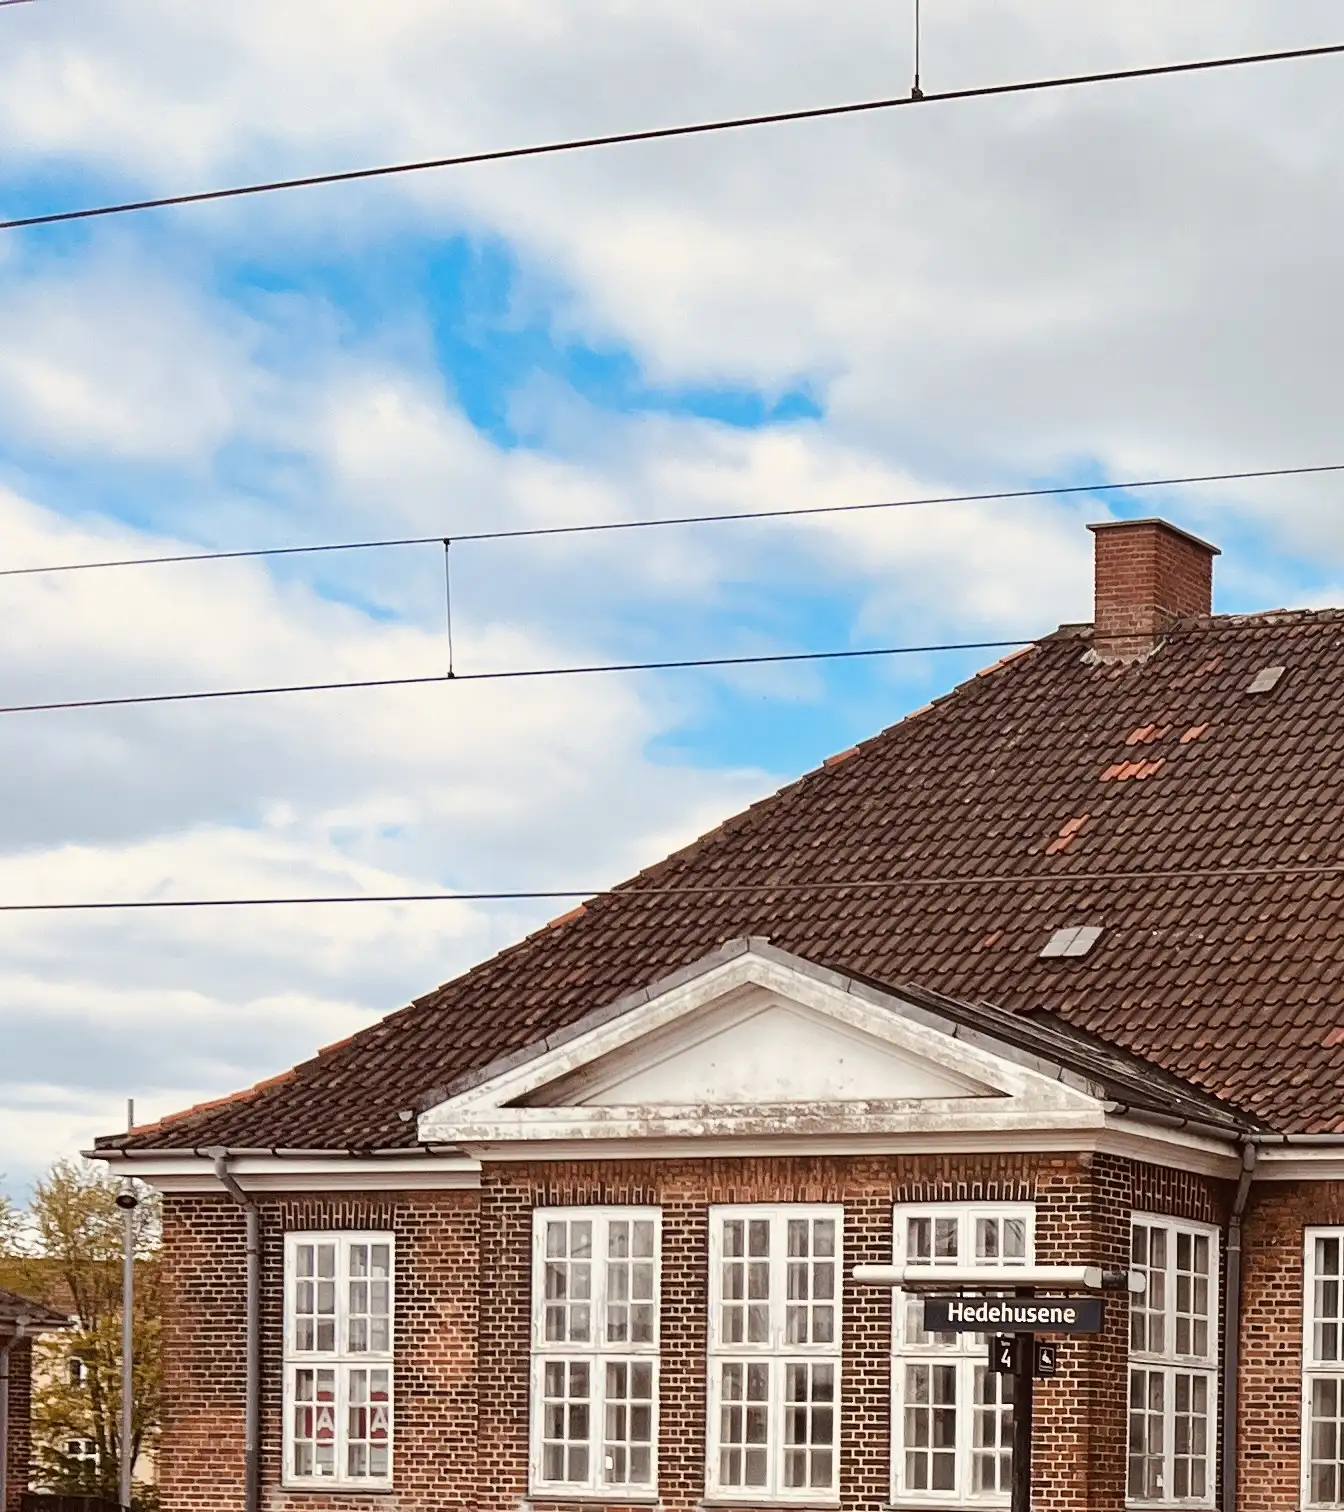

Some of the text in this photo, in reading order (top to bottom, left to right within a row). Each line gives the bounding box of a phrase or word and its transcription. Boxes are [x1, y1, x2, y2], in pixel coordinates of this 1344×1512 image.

[947, 1301, 1076, 1324] Hedehusene
[1000, 1347, 1012, 1368] 4
[316, 1406, 334, 1432] A
[370, 1406, 389, 1433] A
